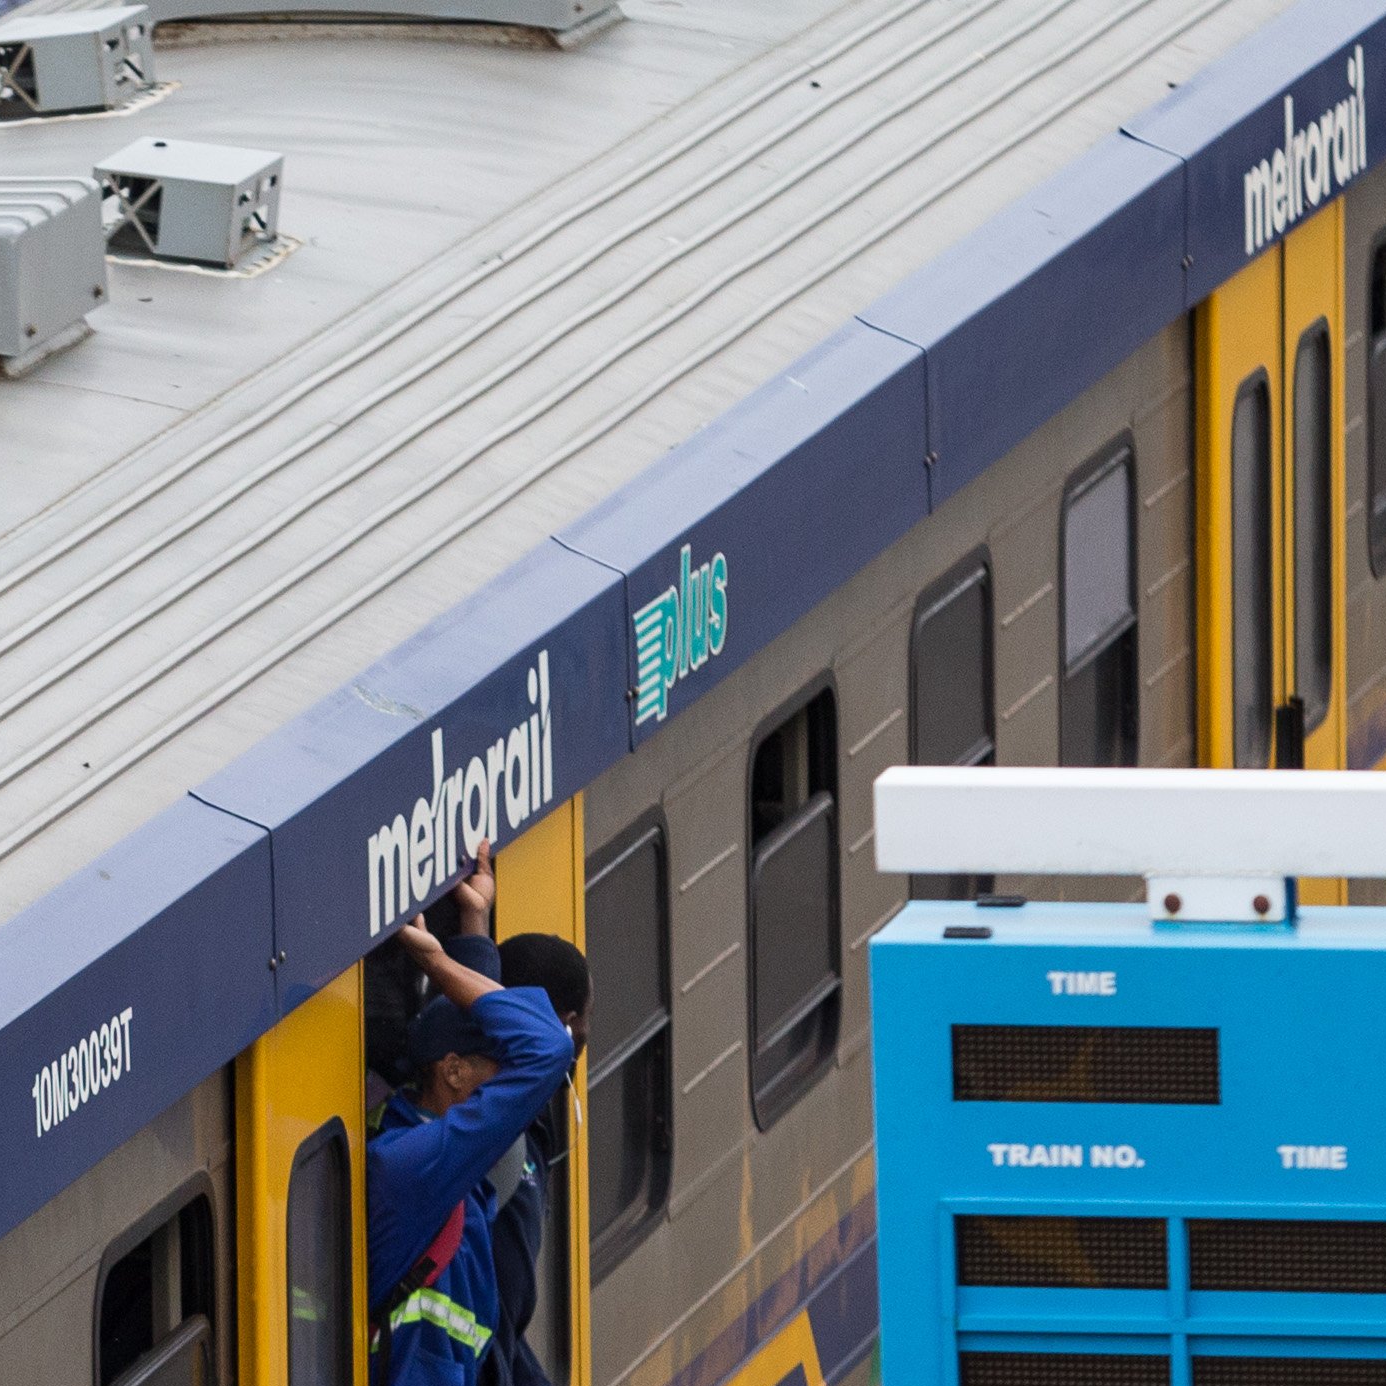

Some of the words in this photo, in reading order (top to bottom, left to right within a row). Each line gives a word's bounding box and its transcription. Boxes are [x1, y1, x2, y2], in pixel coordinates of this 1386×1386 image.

[1244, 44, 1366, 256] metrorail
[633, 543, 728, 726] plus
[368, 649, 553, 938] metrorail
[1047, 971, 1117, 995] TIME
[32, 1006, 133, 1138] 10M30039T
[987, 1143, 1083, 1167] TRAIN
[1090, 1144, 1146, 1168] NO.
[1276, 1145, 1348, 1169] TIME
